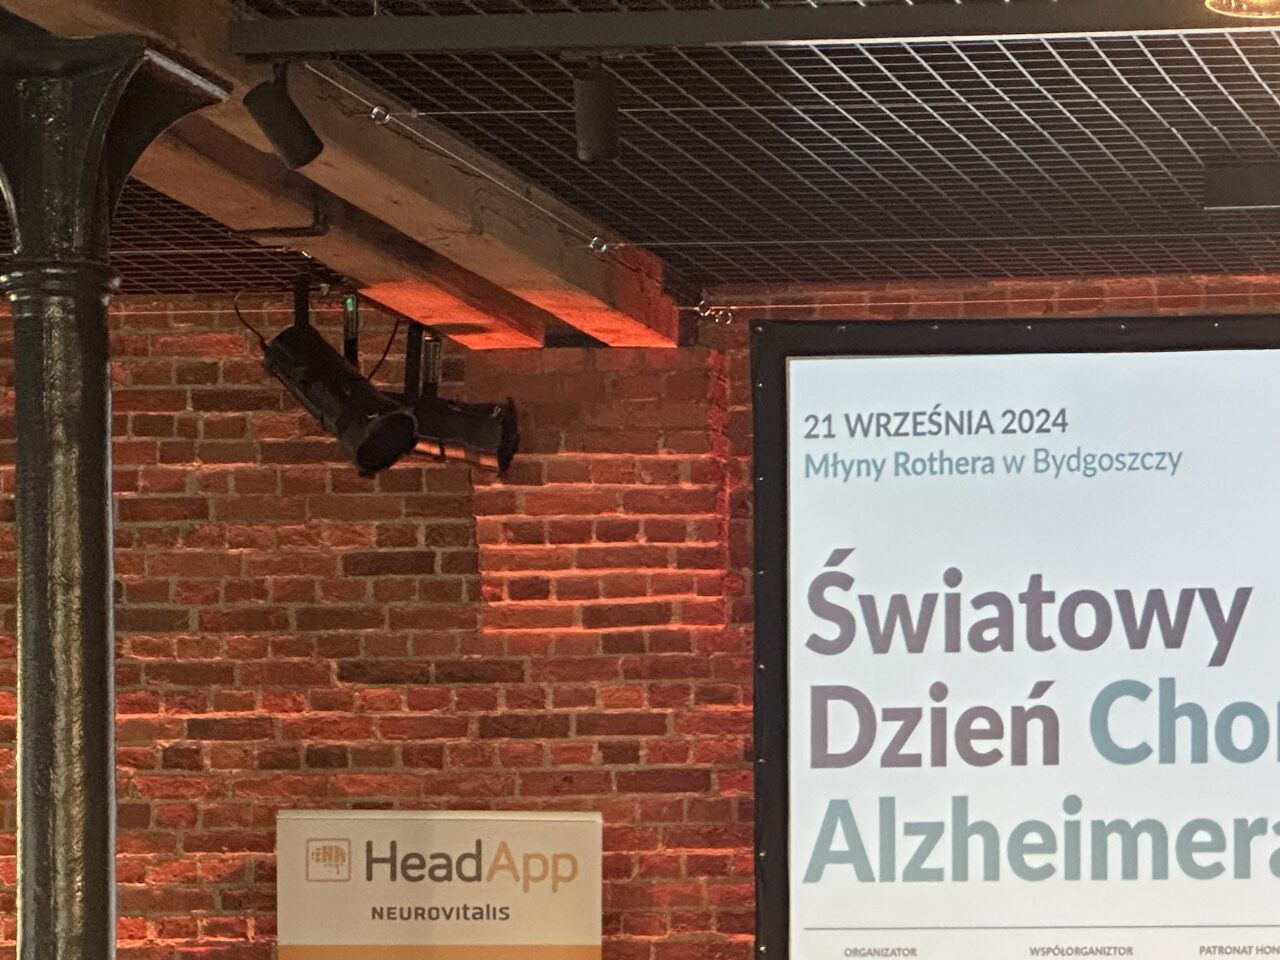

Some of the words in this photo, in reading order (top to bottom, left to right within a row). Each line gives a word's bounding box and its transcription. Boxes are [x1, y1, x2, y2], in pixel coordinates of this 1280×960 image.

[803, 415, 836, 439] 21
[844, 404, 994, 438] WRZEŚNIA
[1001, 408, 1068, 434] 2024
[804, 452, 886, 482] Młyny
[894, 451, 994, 476] Rothera
[1003, 456, 1026, 474] w
[1034, 447, 1183, 477] Bydgoszczy
[805, 548, 1254, 667] Światowy
[809, 680, 1060, 769] Dzień
[364, 839, 579, 893] HeadApp
[844, 947, 918, 957] ORGANIZATOR
[1199, 945, 1253, 955] PATRONAT
